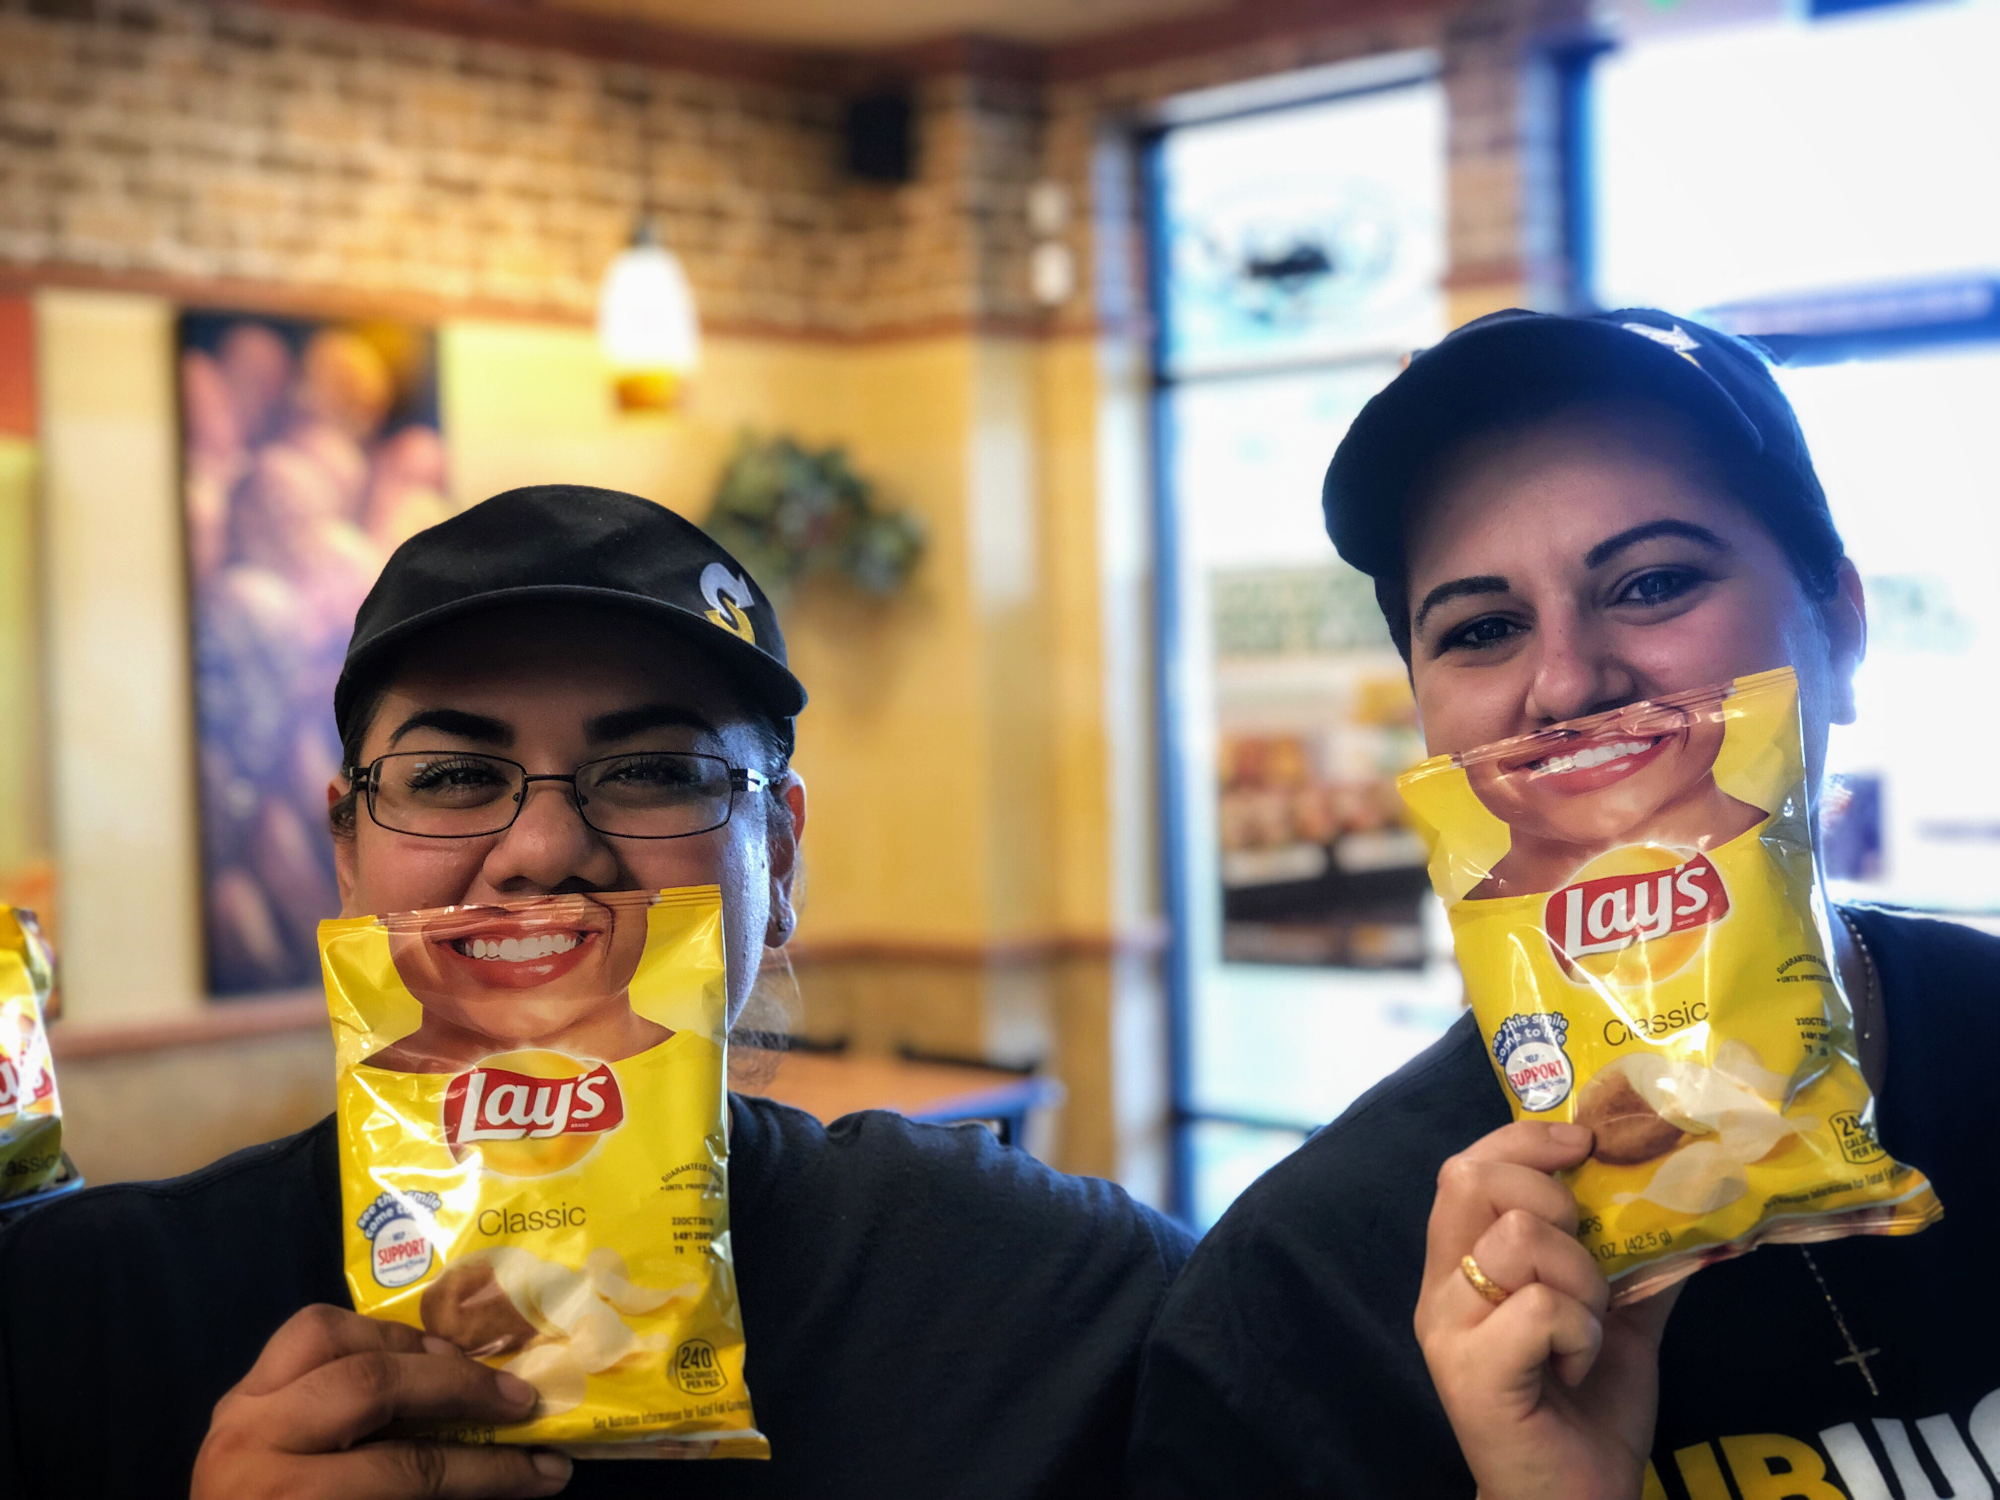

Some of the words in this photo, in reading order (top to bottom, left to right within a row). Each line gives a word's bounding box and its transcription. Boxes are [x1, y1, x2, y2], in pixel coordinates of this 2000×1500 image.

[1565, 864, 1708, 961] Lay's
[1776, 954, 1817, 975] GUARANTEED
[1781, 975, 1800, 983] UNTIL
[1524, 1027, 1541, 1038] to
[1603, 1001, 1709, 1046] Classic
[1508, 1059, 1565, 1089] SUPPORT
[456, 1072, 609, 1144] Lay's
[2, 1151, 57, 1178] assic
[1851, 1148, 1870, 1160] PER
[661, 1163, 708, 1183] GUARANTEED
[364, 1207, 394, 1239] come
[478, 1202, 586, 1236] Classic
[378, 1237, 426, 1266] SUPPORT
[681, 1346, 711, 1369] 240
